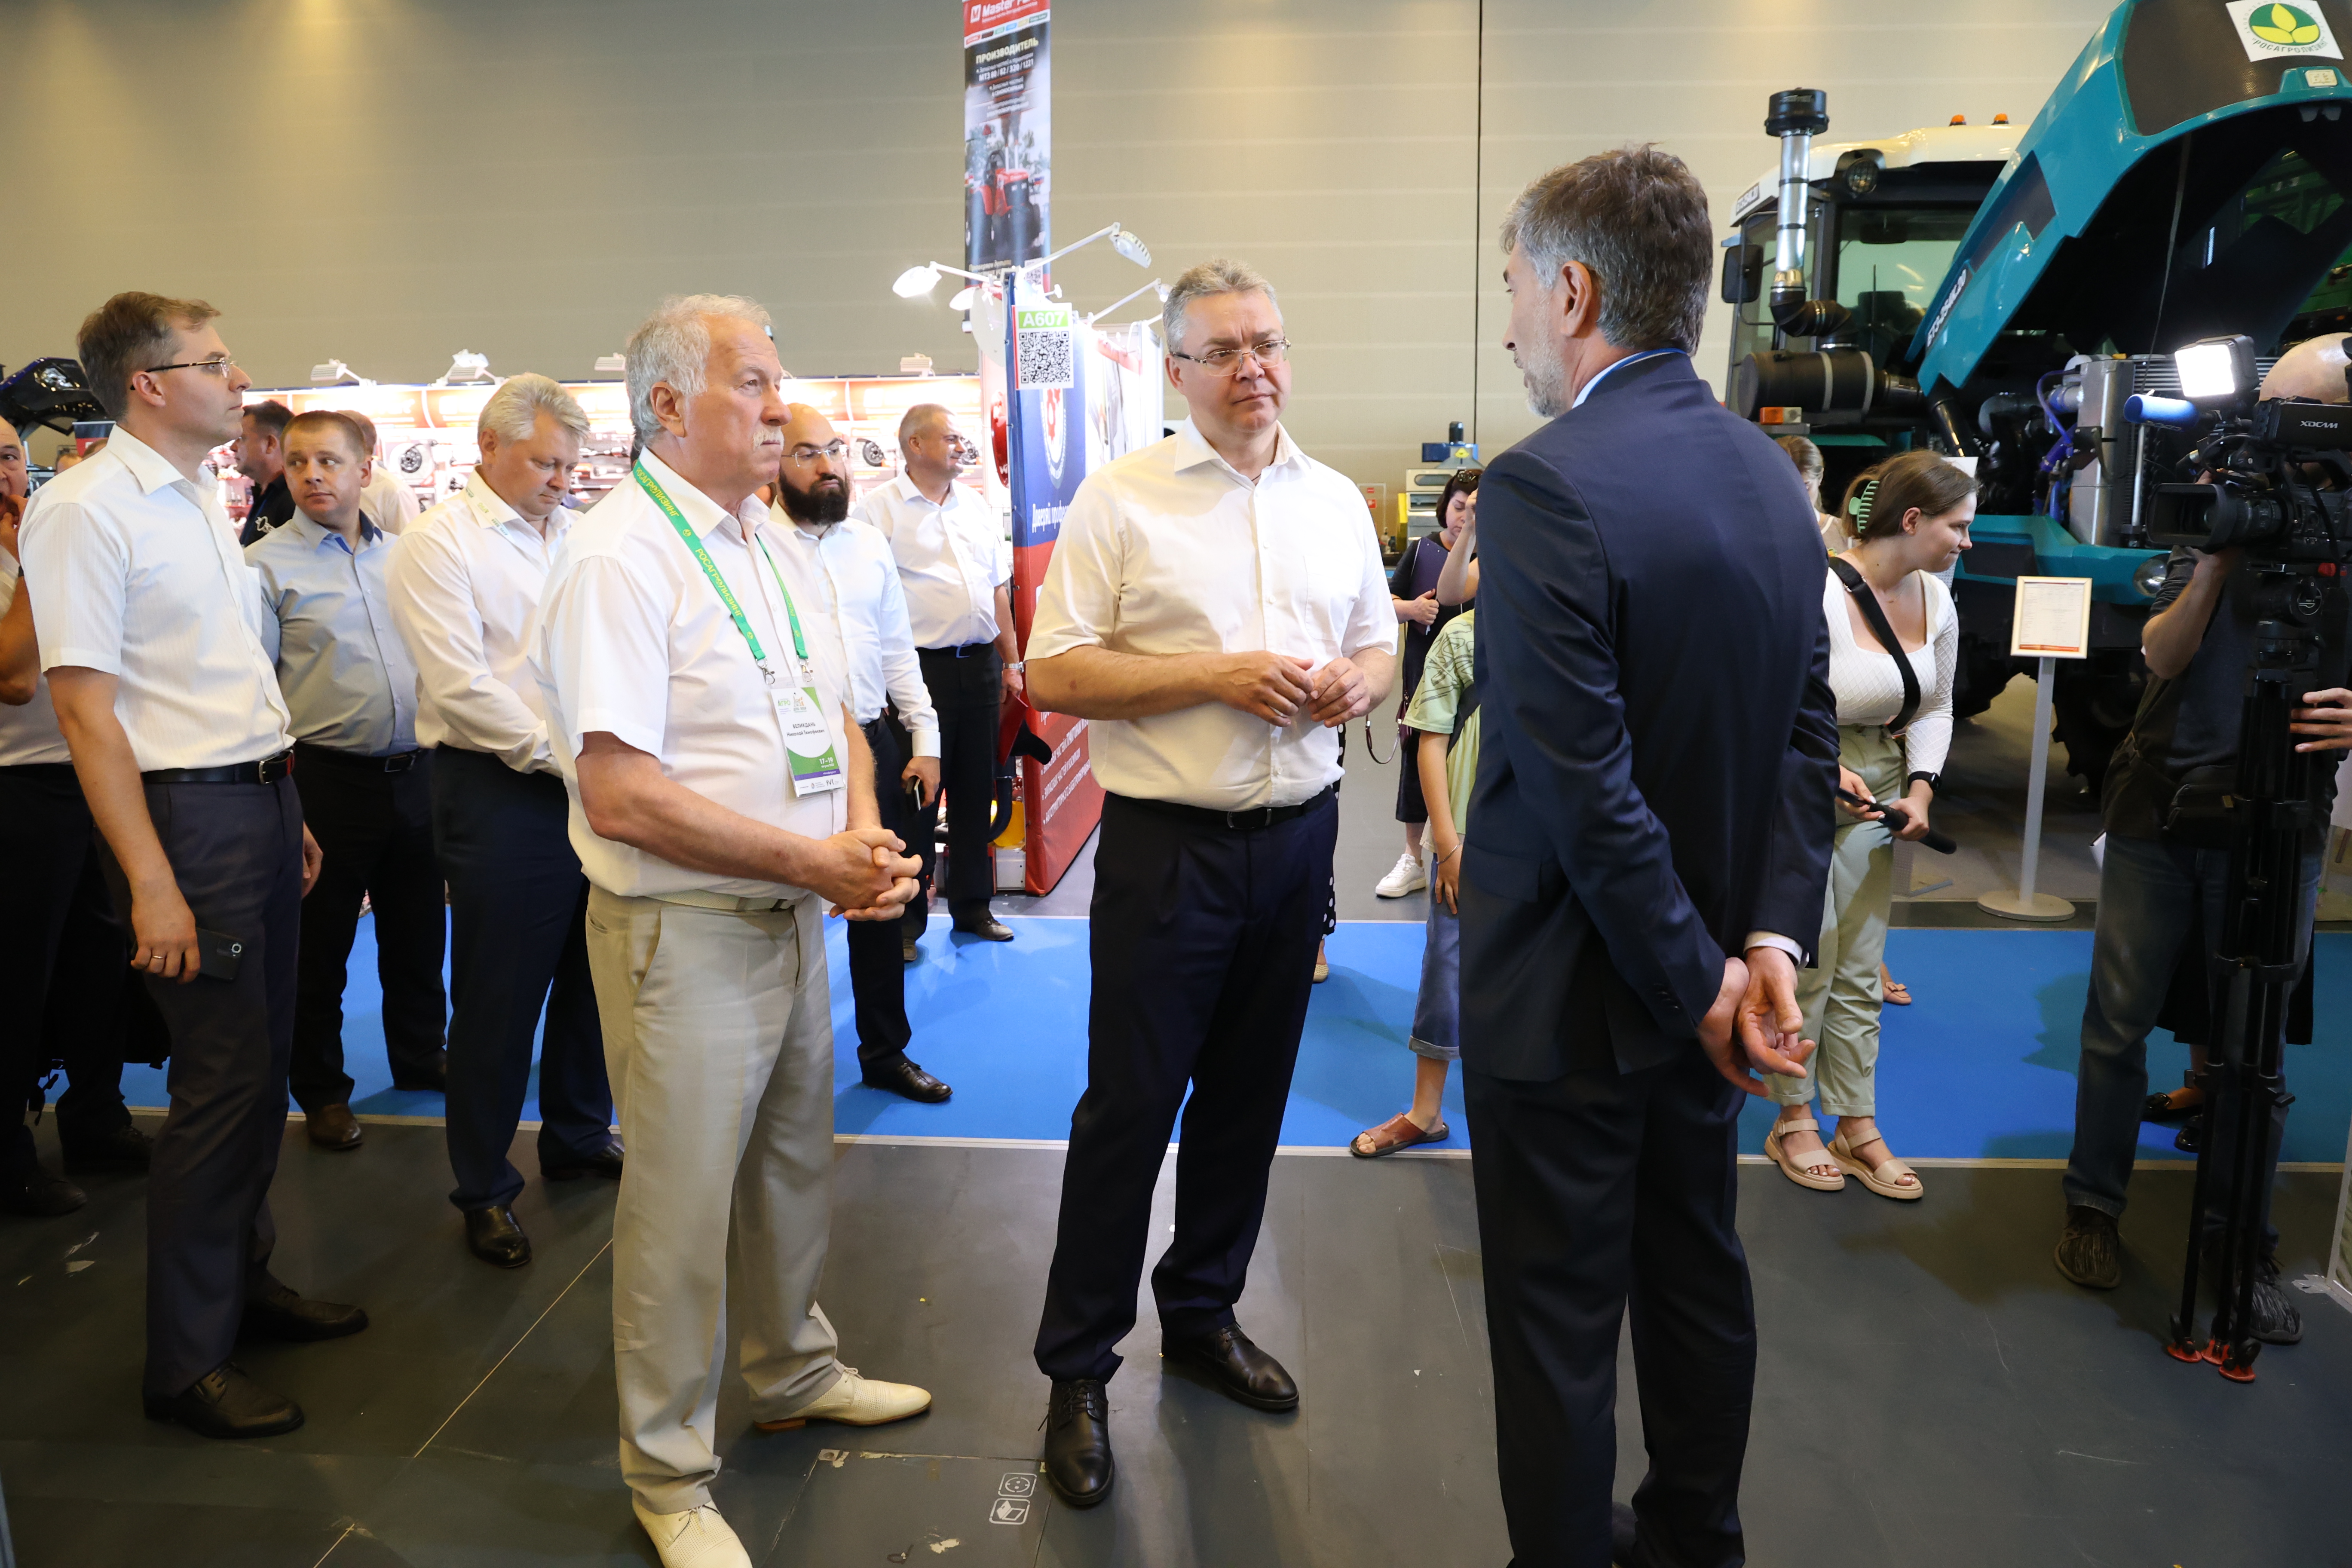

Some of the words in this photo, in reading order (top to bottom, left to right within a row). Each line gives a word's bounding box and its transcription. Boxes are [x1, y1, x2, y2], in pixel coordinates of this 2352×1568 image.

[976, 37, 1039, 64] ПРОИЗВОДИТЕЛЬ
[979, 73, 990, 81] МТЗ
[1023, 312, 1065, 327] A607
[636, 467, 679, 516] РОСАГРОЛИЗИНГ
[1032, 502, 1052, 533] Доверяй
[695, 548, 743, 618] РОСАГРОЛИЗИНГ
